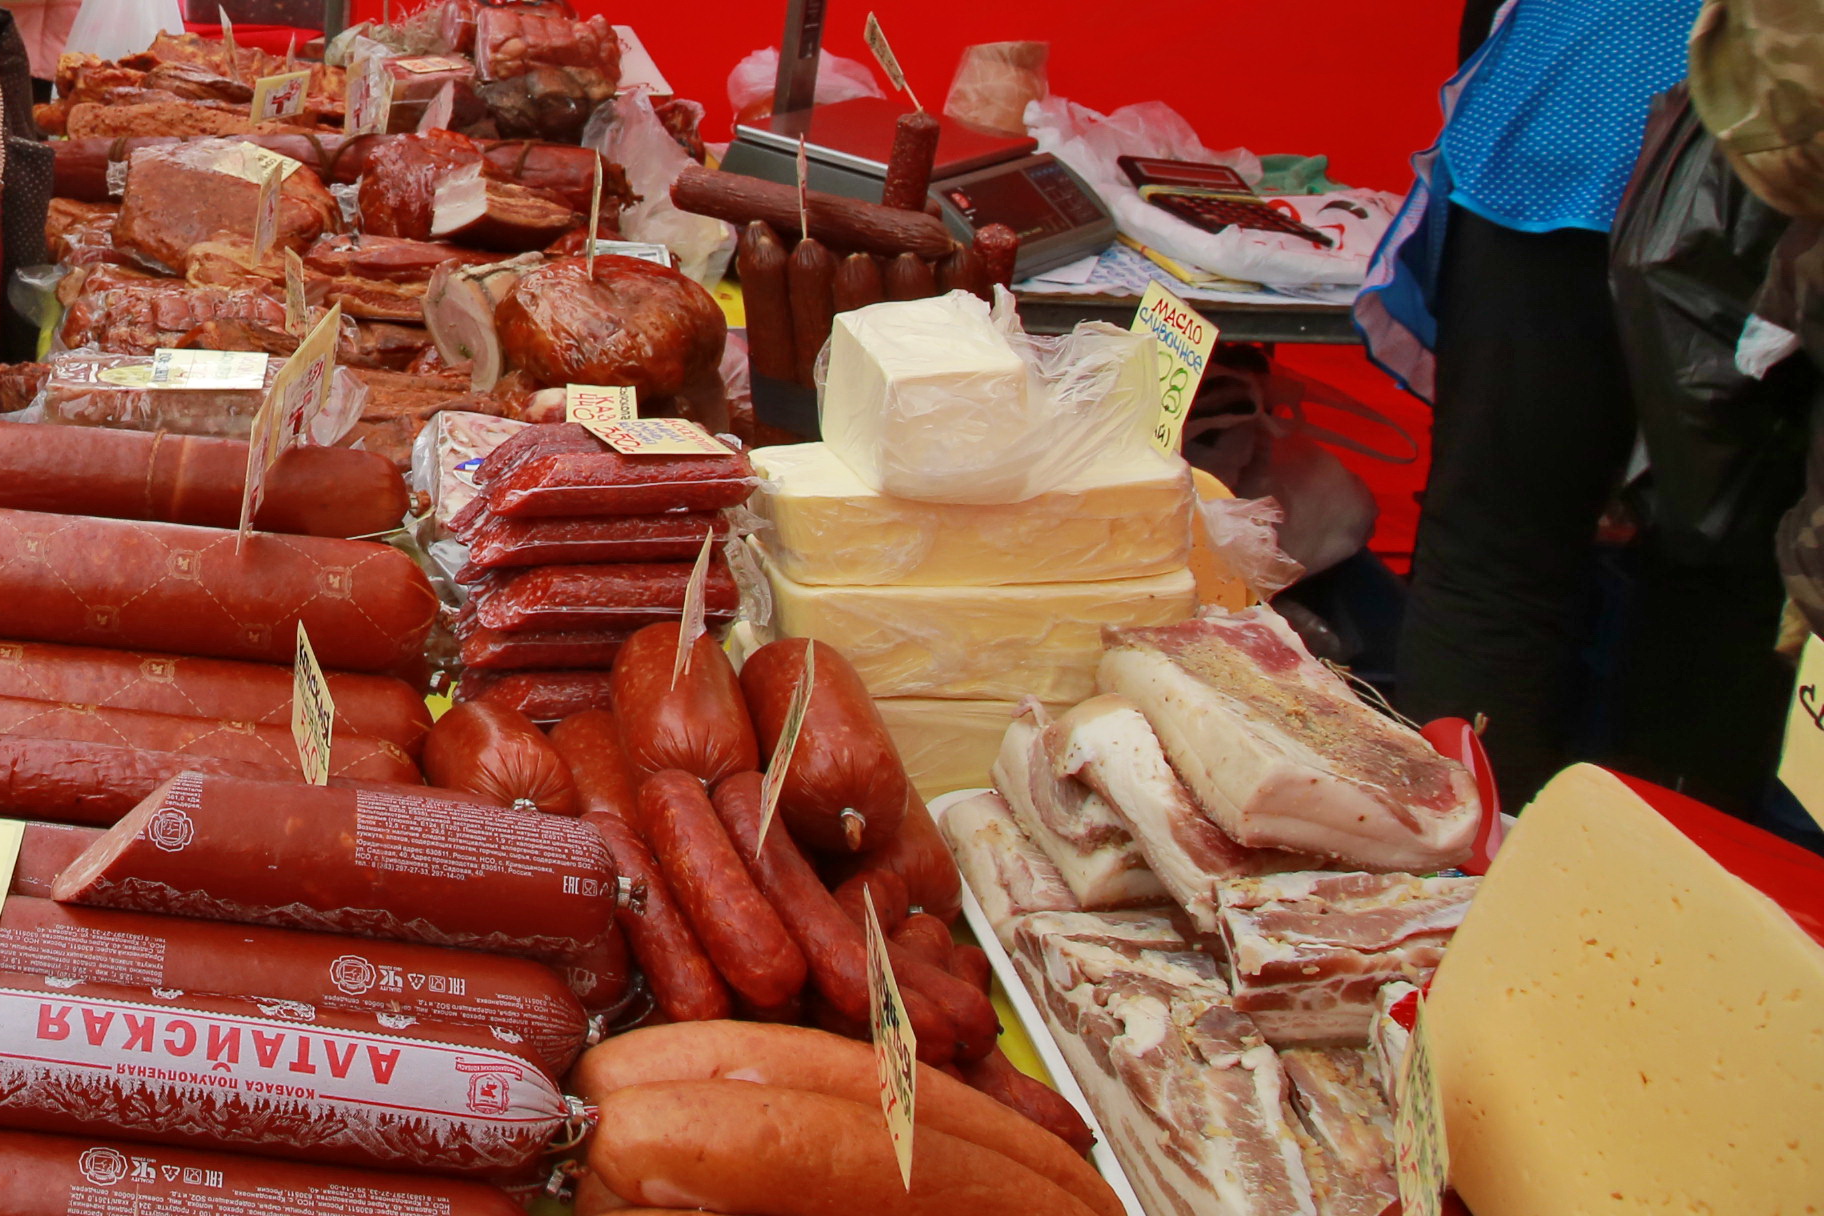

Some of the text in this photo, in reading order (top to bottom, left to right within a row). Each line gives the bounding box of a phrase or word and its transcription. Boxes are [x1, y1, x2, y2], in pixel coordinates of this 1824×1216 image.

[1151, 298, 1204, 345] МАСЛО
[35, 1002, 402, 1085] АЛТАЙСКАЯ
[115, 1062, 316, 1100] КОЛБАСА ПОЛУКОПЧЕНАЯ
